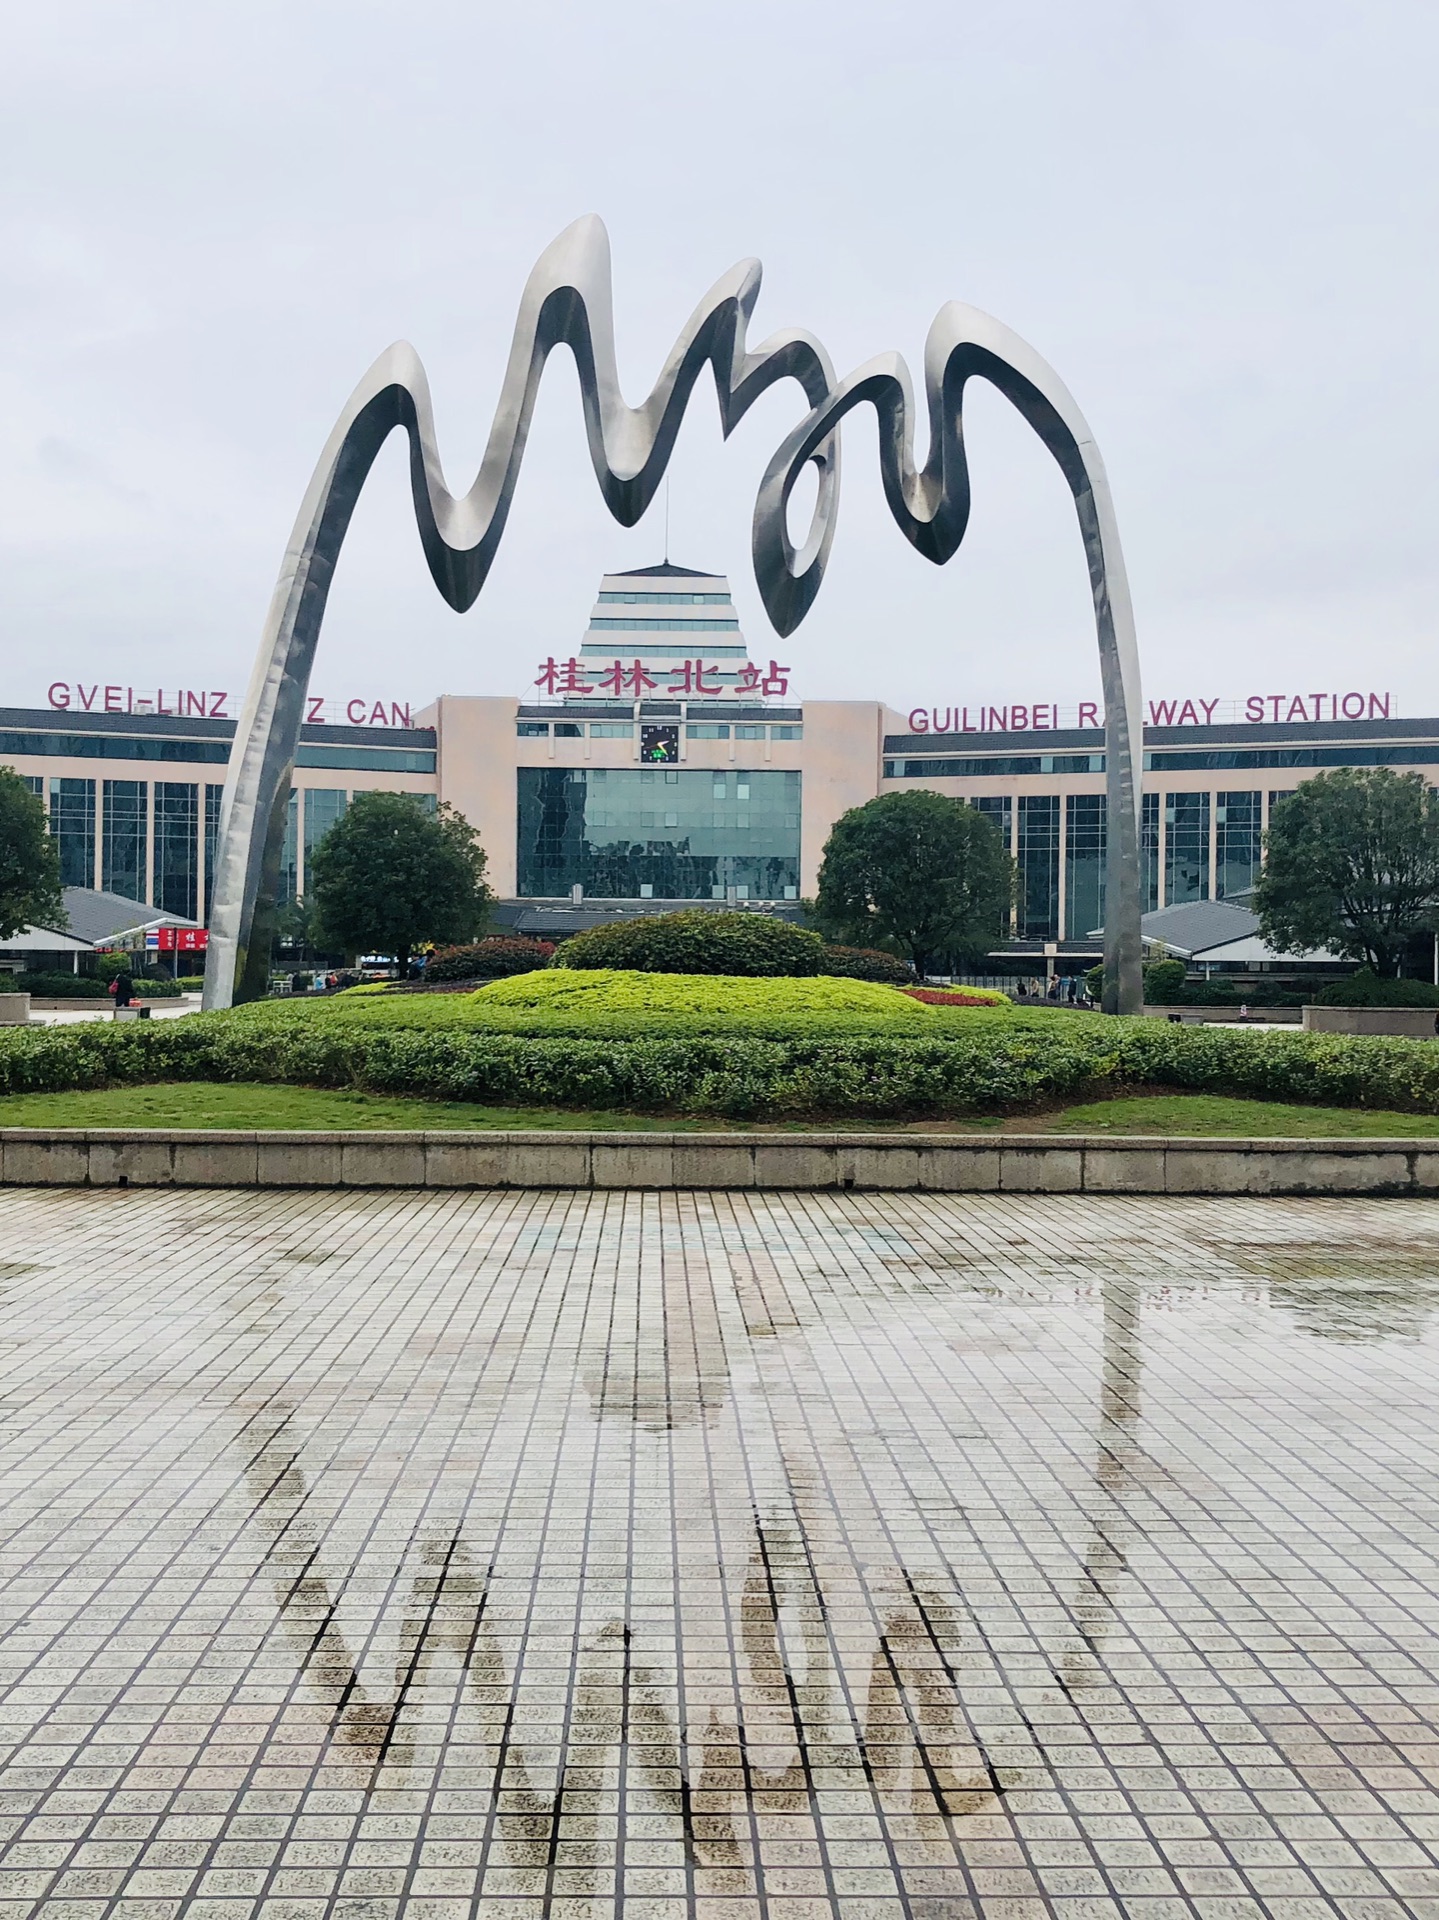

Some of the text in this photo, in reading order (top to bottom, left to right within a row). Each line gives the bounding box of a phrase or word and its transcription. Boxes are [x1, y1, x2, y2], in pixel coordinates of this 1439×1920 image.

[534, 657, 791, 697] 桂林北站
[48, 682, 228, 718] GVEI-LINZ
[347, 698, 410, 728] CAN
[908, 692, 1389, 733] GUILINBEI RWAY STATION
